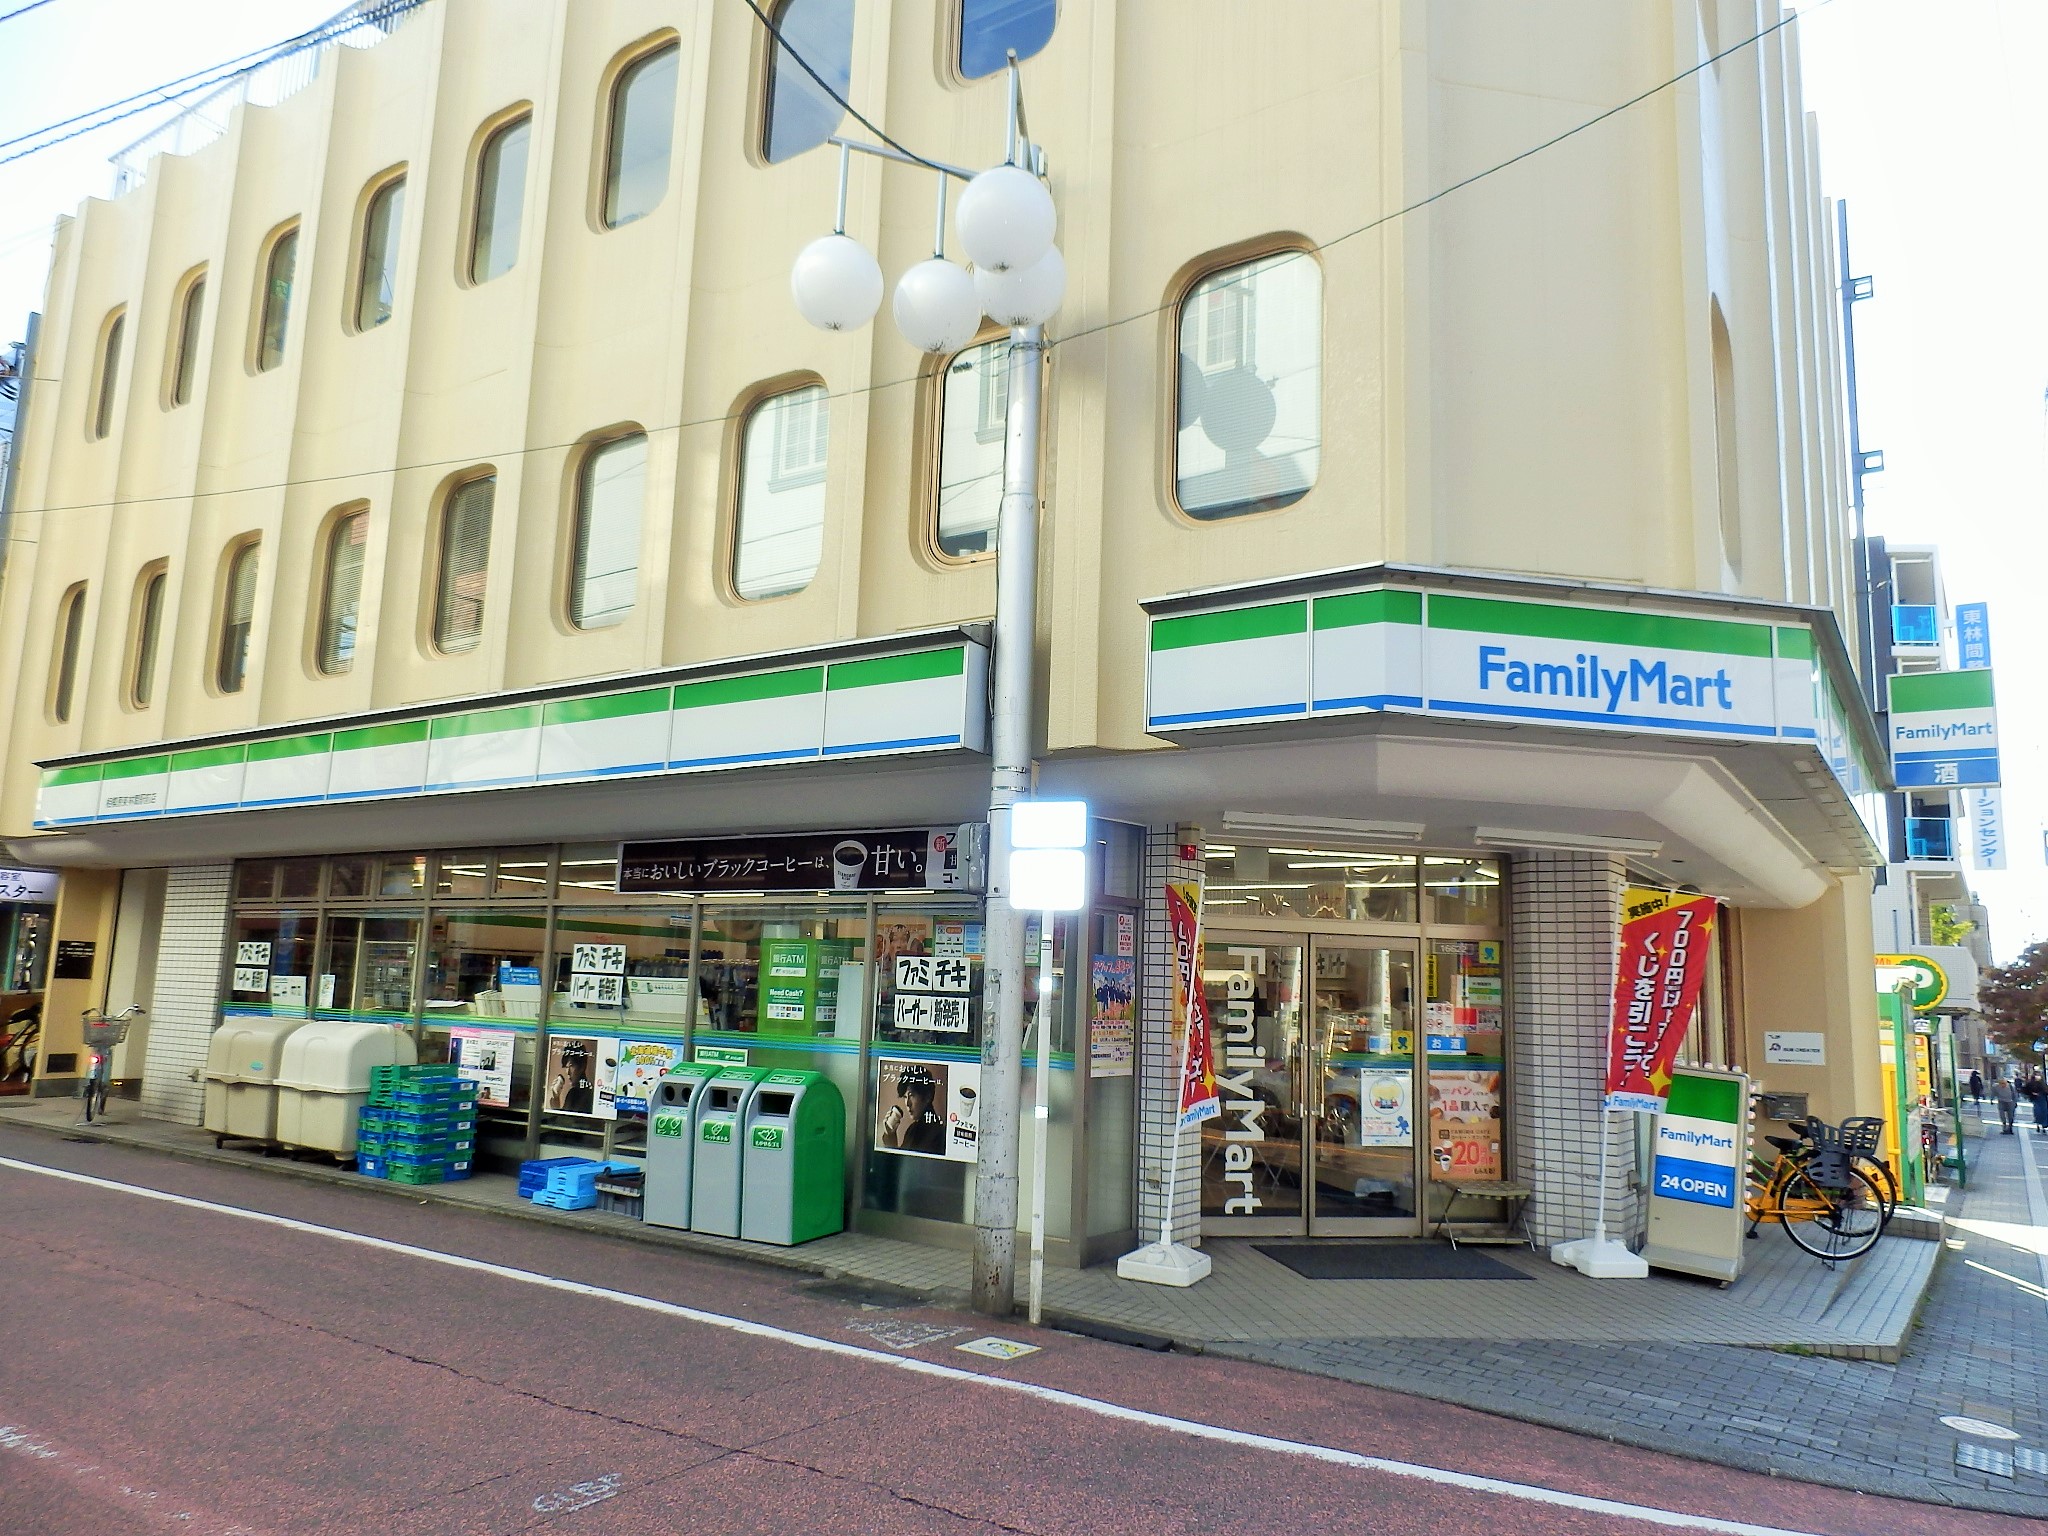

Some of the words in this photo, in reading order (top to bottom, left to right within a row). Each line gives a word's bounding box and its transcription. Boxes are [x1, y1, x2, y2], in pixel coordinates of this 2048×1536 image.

[1480, 646, 1732, 713] FamilyMart
[1896, 722, 1993, 740] FamilyMart
[1934, 763, 1958, 784] 酒
[623, 853, 830, 880] 本当においしいブラックコーヒーは、
[871, 844, 923, 876] 甘い。
[576, 946, 623, 970] ファミチキ
[899, 959, 967, 987] ファミチキ
[1215, 946, 1266, 1214] FamilyMart
[1613, 1095, 1658, 1111] FamilyMart
[924, 1111, 944, 1125] 甘い。
[952, 1138, 976, 1148] コーヒー
[1660, 1127, 1733, 1148] FamilyMart
